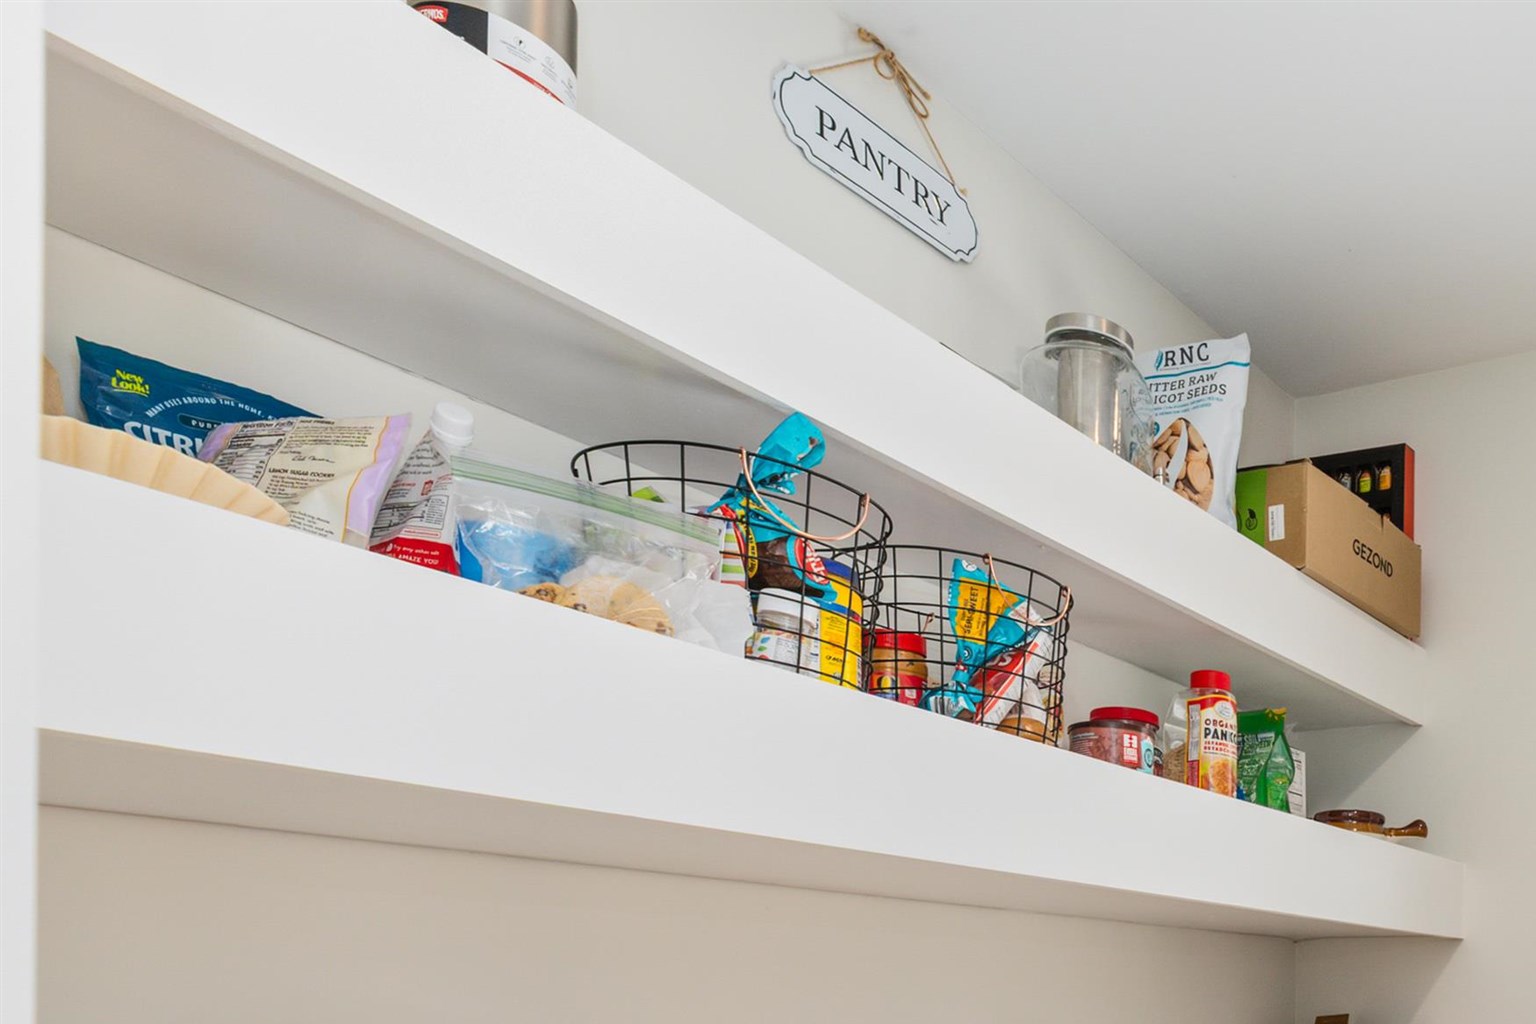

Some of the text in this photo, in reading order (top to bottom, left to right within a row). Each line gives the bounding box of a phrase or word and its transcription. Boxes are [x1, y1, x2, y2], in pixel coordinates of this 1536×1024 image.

[815, 105, 951, 226] PANTRY
[1164, 343, 1209, 367] RNC
[111, 376, 150, 394] Look!
[115, 368, 145, 384] New
[1149, 372, 1218, 392] ITTER RAW
[1153, 384, 1227, 405] ICOT SEEDS
[145, 403, 164, 418] MANY
[181, 396, 217, 405] AROUND
[219, 399, 235, 407] THE
[1352, 539, 1393, 578] GEZOND
